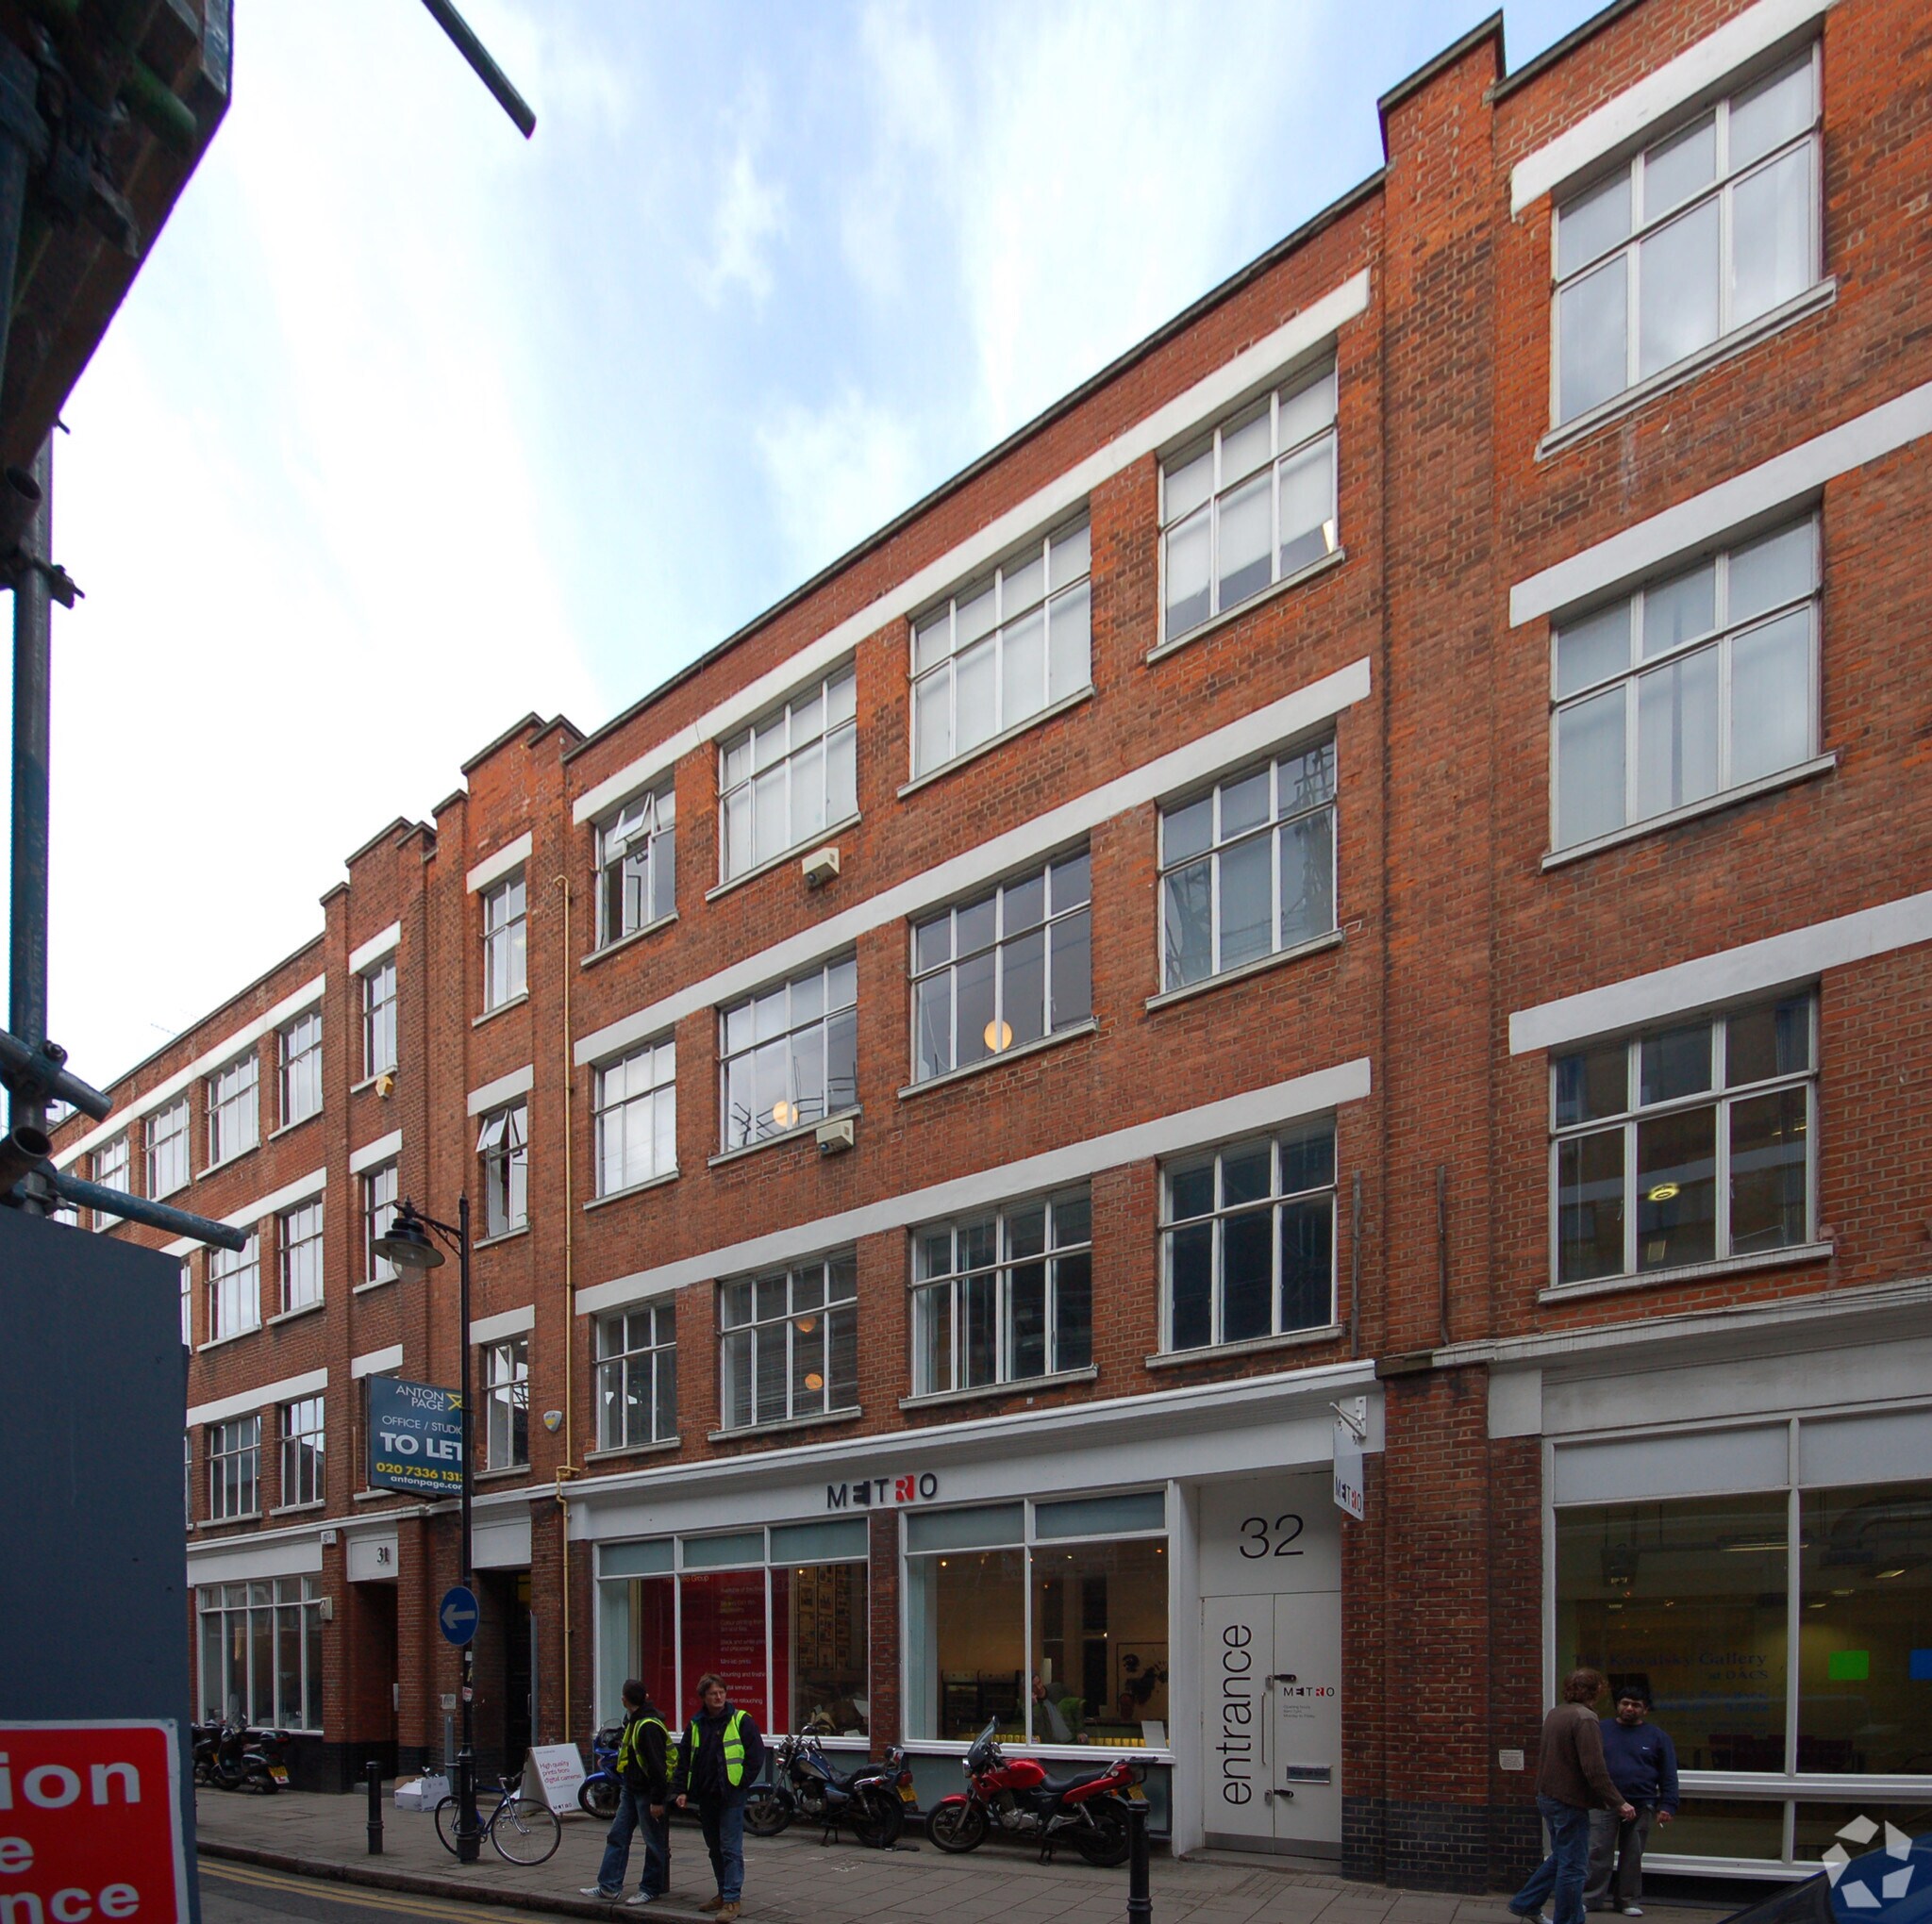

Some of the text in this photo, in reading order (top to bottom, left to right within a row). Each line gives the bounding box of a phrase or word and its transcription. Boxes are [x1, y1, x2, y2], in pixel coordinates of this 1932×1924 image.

[395, 1385, 444, 1402] ANTON
[411, 1397, 444, 1412] PAGE
[381, 1415, 421, 1430] OFFICE
[424, 1421, 429, 1431] /
[379, 1432, 462, 1462] TO LET
[376, 1462, 403, 1475] 020
[406, 1466, 438, 1480] 7336
[826, 1472, 938, 1509] METRO
[1335, 1475, 1362, 1513] METRO
[1239, 1514, 1305, 1560] 32
[377, 1547, 389, 1563] 31
[691, 1575, 709, 1584] Group
[1699, 1651, 1768, 1667] Gallery
[1725, 1669, 1769, 1680] DACS
[1283, 1686, 1336, 1698] METRO
[1215, 1623, 1253, 1805] entrance
